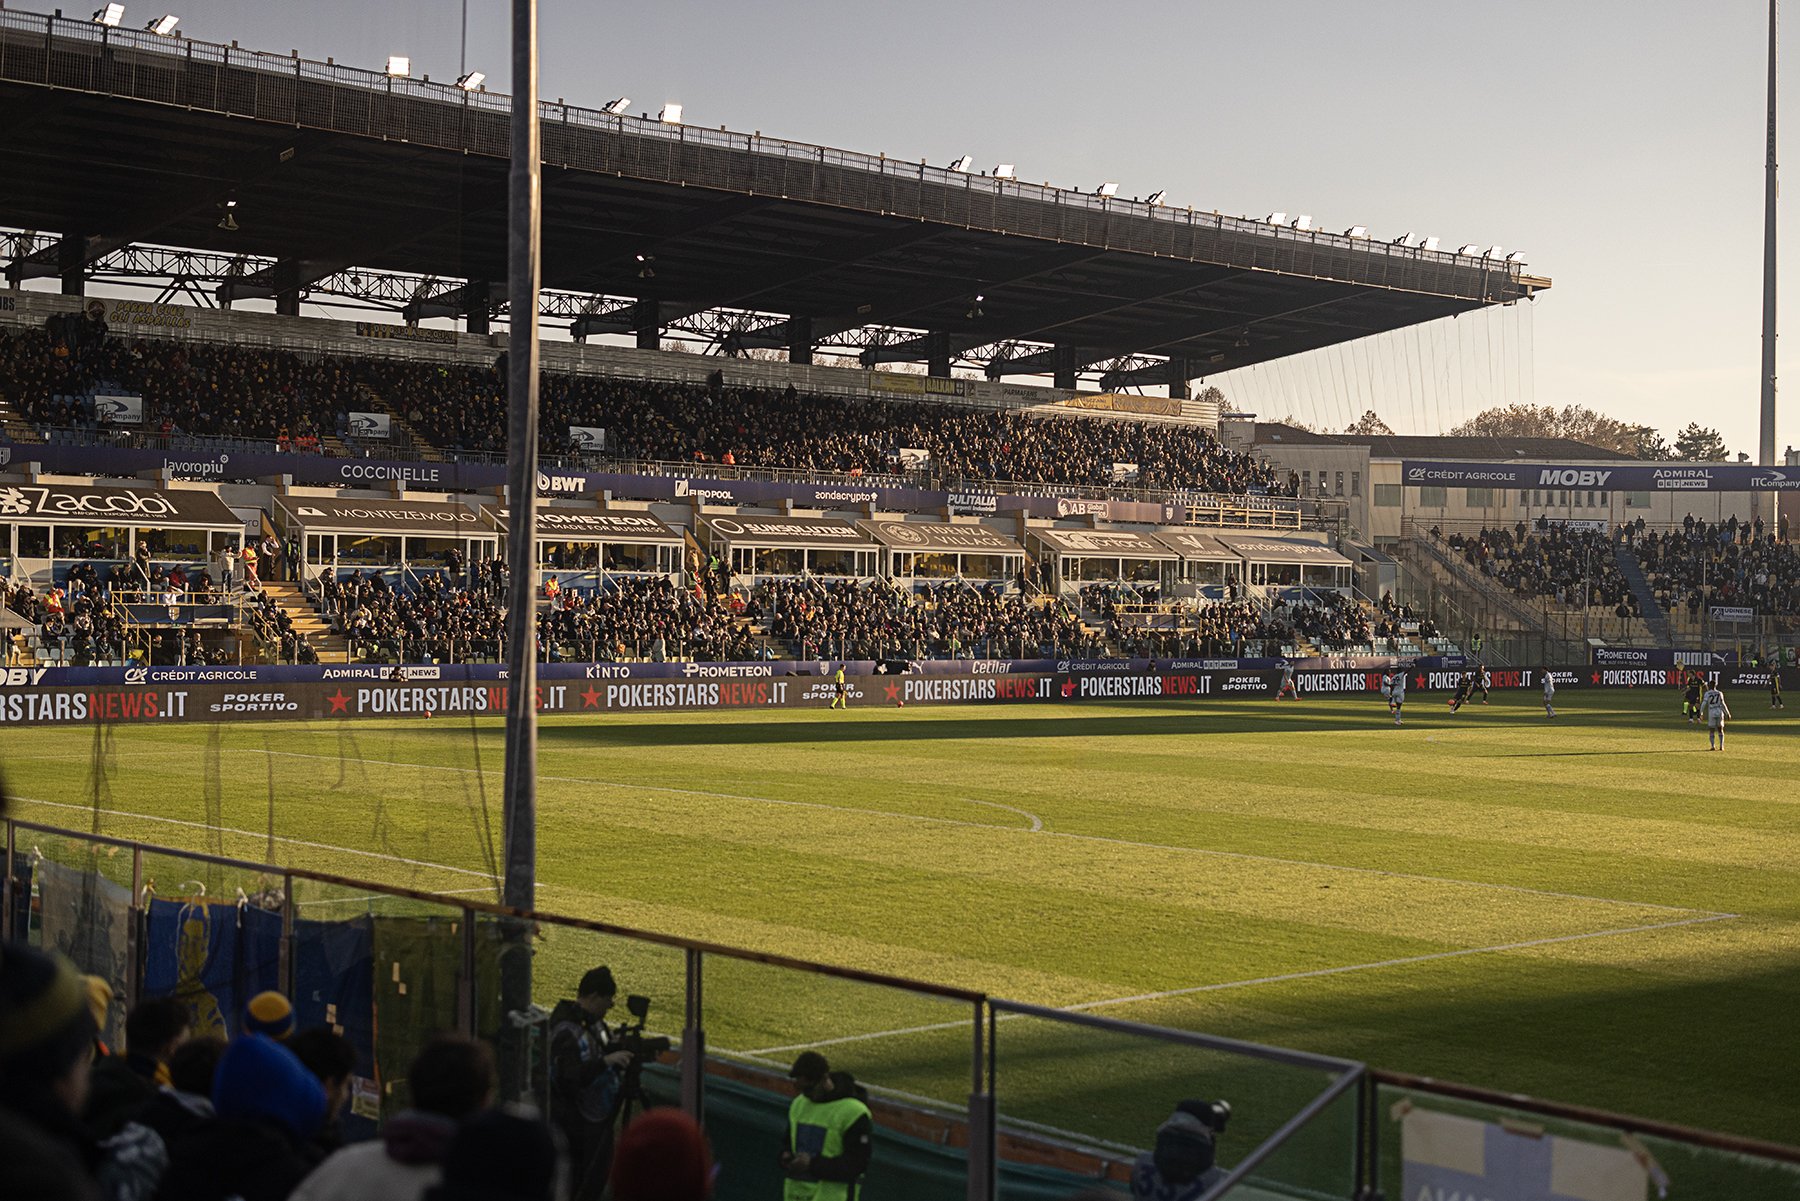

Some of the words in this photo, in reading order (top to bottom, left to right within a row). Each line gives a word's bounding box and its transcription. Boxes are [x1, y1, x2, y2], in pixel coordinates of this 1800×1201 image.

[340, 464, 439, 482] COCCINELLE
[1427, 468, 1464, 481] CRÉDIT
[1465, 470, 1516, 482] AGRICOLE
[1539, 468, 1612, 487] MOBY
[1653, 468, 1713, 479] ADMIRAL
[551, 476, 586, 492] BWT
[20, 486, 179, 515] Zacobi
[815, 490, 871, 503] zondacrypto
[947, 493, 997, 506] PULITALIA
[333, 508, 477, 522] MONTEZEMOLO
[1071, 503, 1086, 515] AB
[551, 523, 586, 531] MADE
[611, 525, 666, 533] BUSINESS
[743, 523, 859, 536] SUNSOLUTION
[919, 525, 994, 537] FIDENZA
[932, 535, 1007, 547] VILLAGE
[1596, 648, 1647, 660] PROMETEON
[1673, 651, 1712, 666] PUMA
[682, 663, 772, 678] PROMETEON
[972, 660, 1012, 675] Cetilar
[1071, 661, 1096, 671] CRÉDIT
[1097, 662, 1130, 671] AGRICOLE
[1171, 661, 1202, 669] ADMIRAL
[151, 668, 196, 681] CRÉDIT
[197, 670, 257, 681] AGRICOLE
[322, 668, 378, 679] ADMIRAL
[1080, 675, 1213, 697] POKERSTARSNEWS.IT
[1228, 676, 1261, 684] POKER
[811, 683, 855, 692] POKR
[904, 677, 1052, 701] POKERSTARSNEWS.IT
[1221, 683, 1268, 691] SPORTIVO
[223, 693, 285, 702] POKER
[607, 681, 788, 708] POKERSTARSNEWS.IT
[802, 691, 864, 700] SPORVO
[1709, 694, 1720, 705] 27
[209, 702, 298, 712] SPORTIVO
